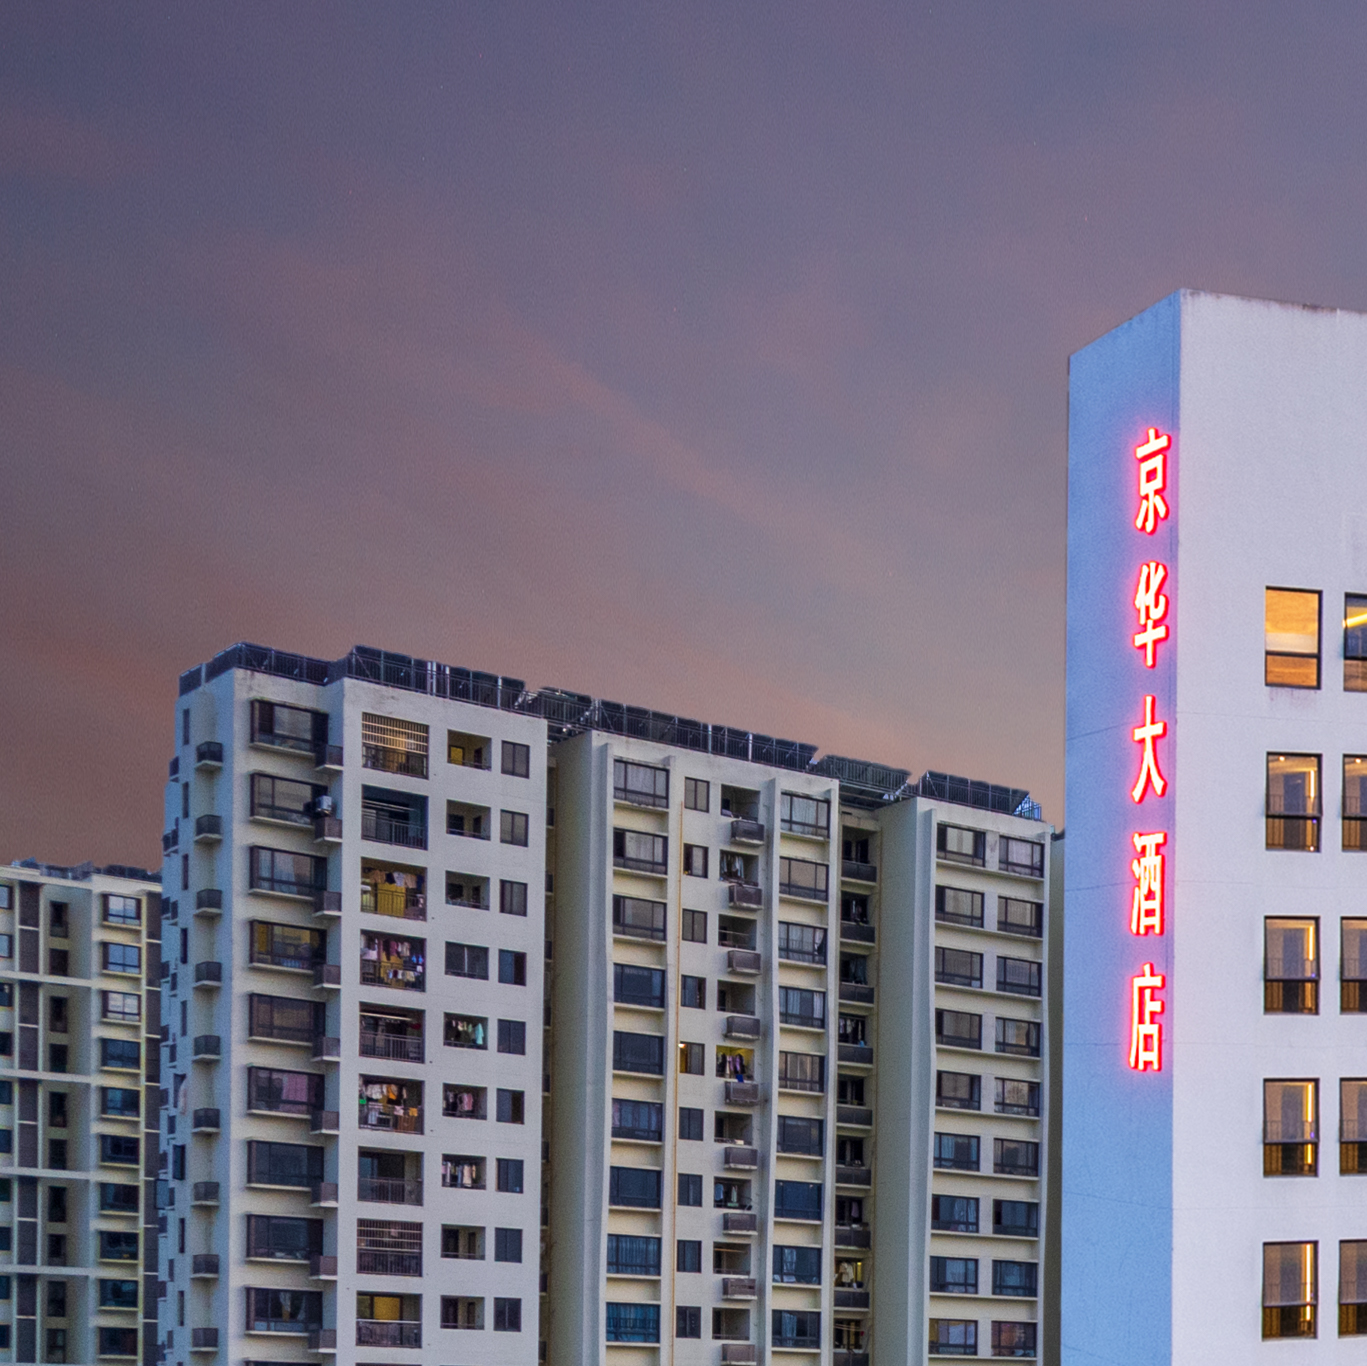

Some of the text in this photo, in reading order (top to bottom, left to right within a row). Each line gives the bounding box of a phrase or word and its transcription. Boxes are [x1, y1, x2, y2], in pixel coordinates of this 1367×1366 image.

[1129, 427, 1171, 1072] 京华大酒店
